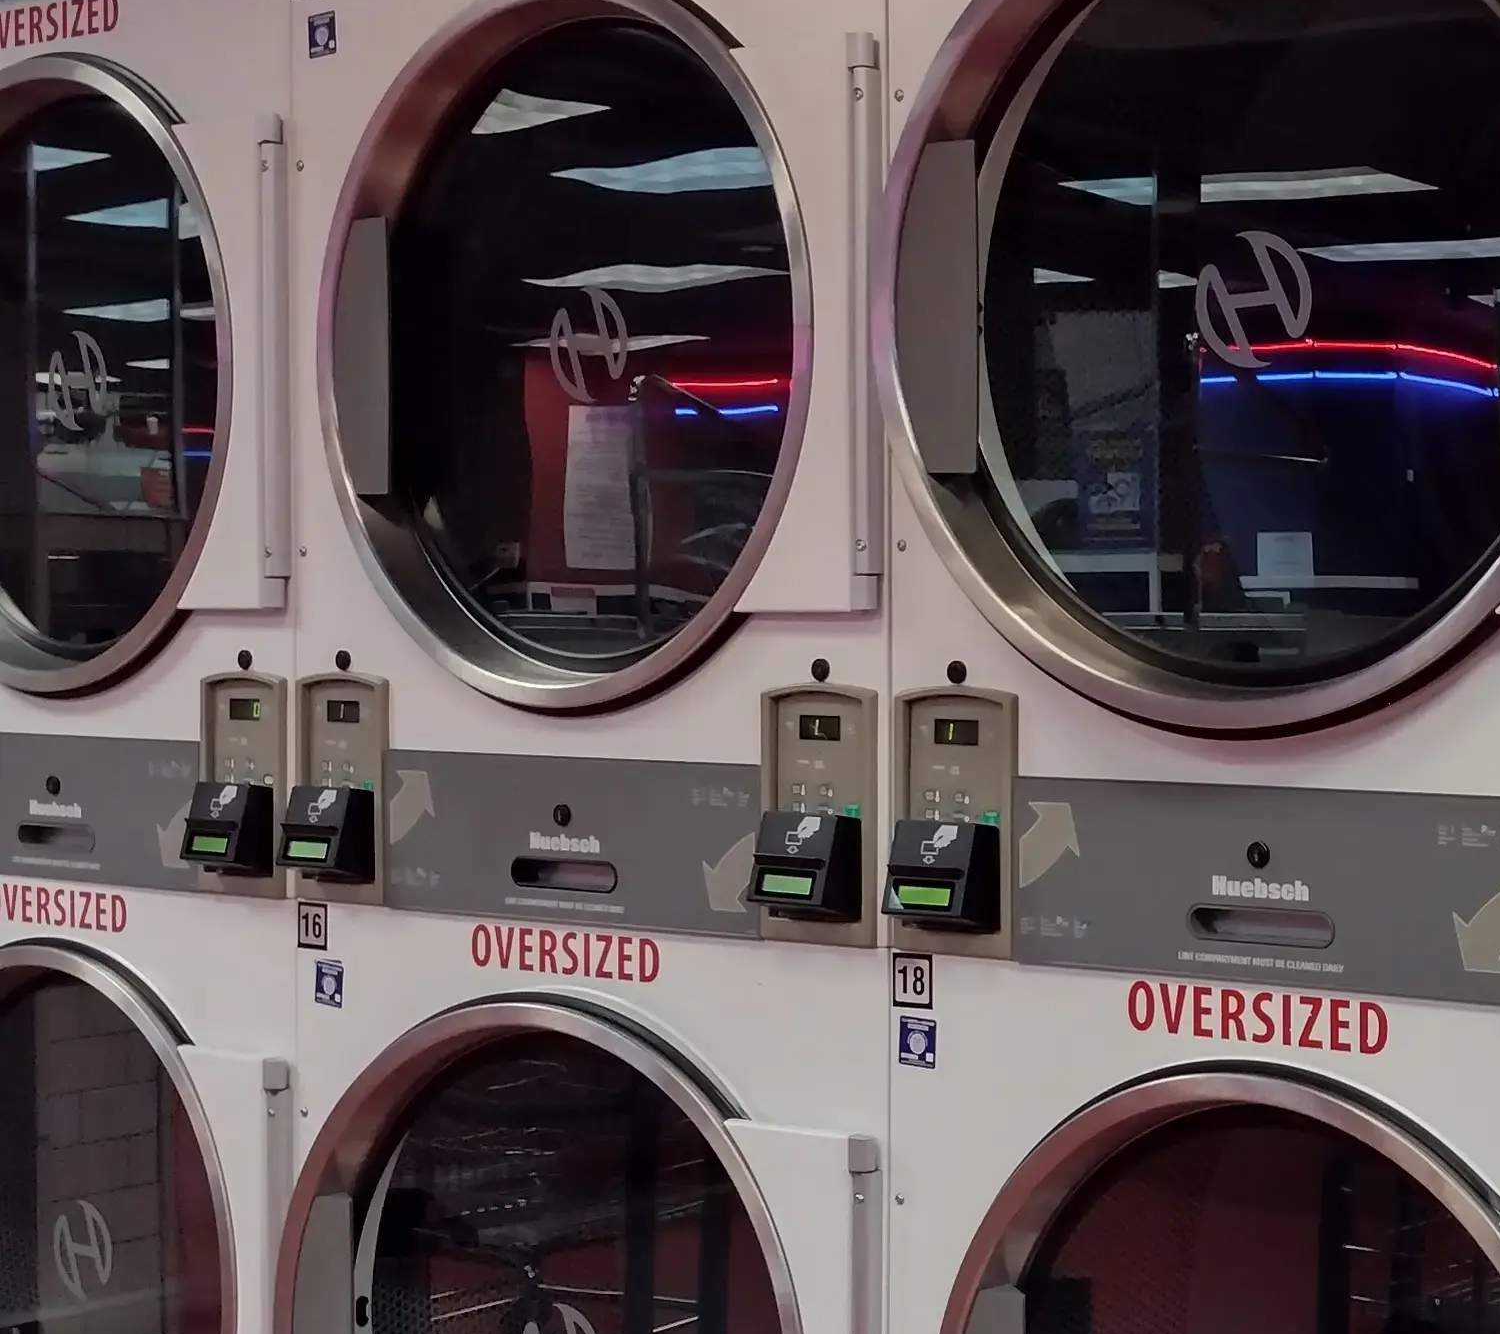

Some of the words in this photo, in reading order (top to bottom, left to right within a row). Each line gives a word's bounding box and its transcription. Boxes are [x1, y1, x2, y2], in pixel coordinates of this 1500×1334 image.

[1212, 875, 1309, 901] Huebsch
[0, 884, 127, 932] VERSIZED
[302, 912, 322, 938] 16
[470, 923, 660, 983] OVERSIZED
[898, 965, 925, 995] 18
[1127, 980, 1389, 1055] OVERSIZED
